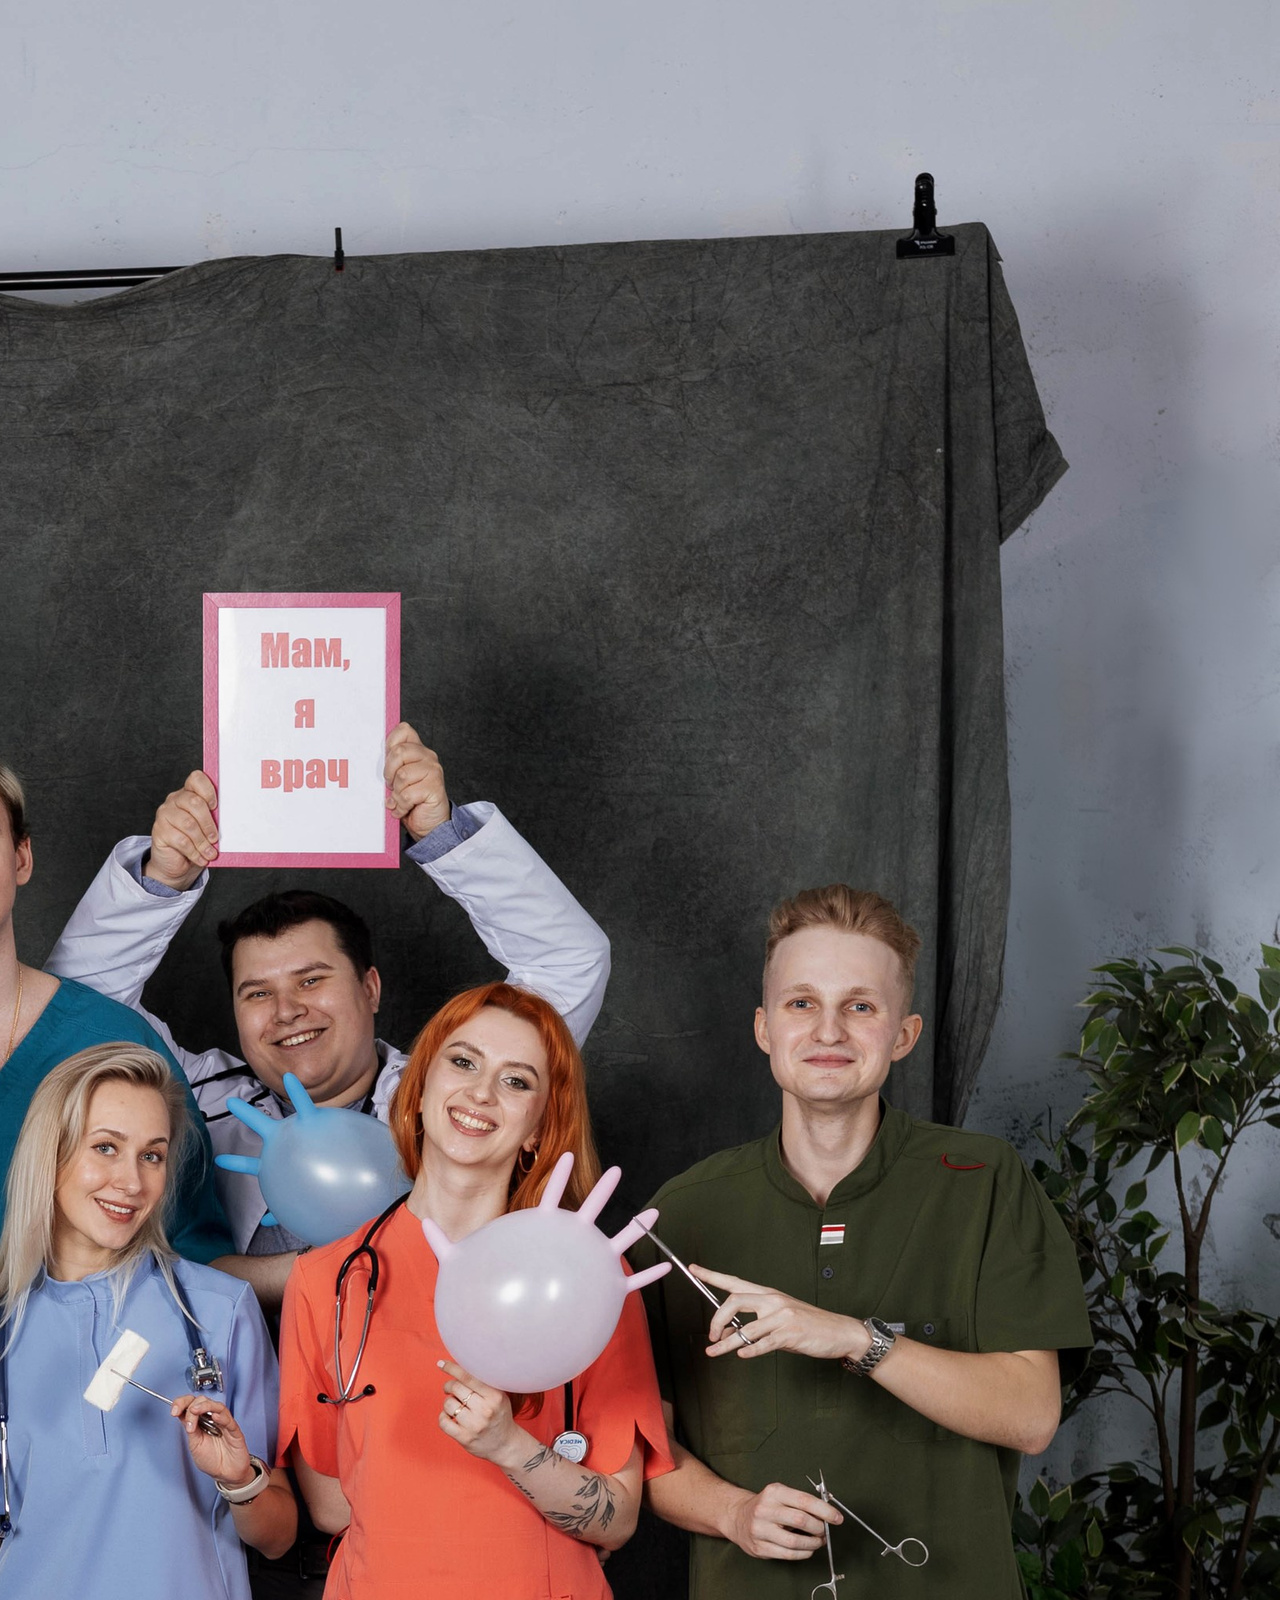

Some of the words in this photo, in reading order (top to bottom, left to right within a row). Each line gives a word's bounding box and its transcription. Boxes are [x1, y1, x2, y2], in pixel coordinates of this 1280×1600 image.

[261, 632, 350, 671] Мам,
[294, 699, 315, 728] я
[261, 759, 349, 792] врач
